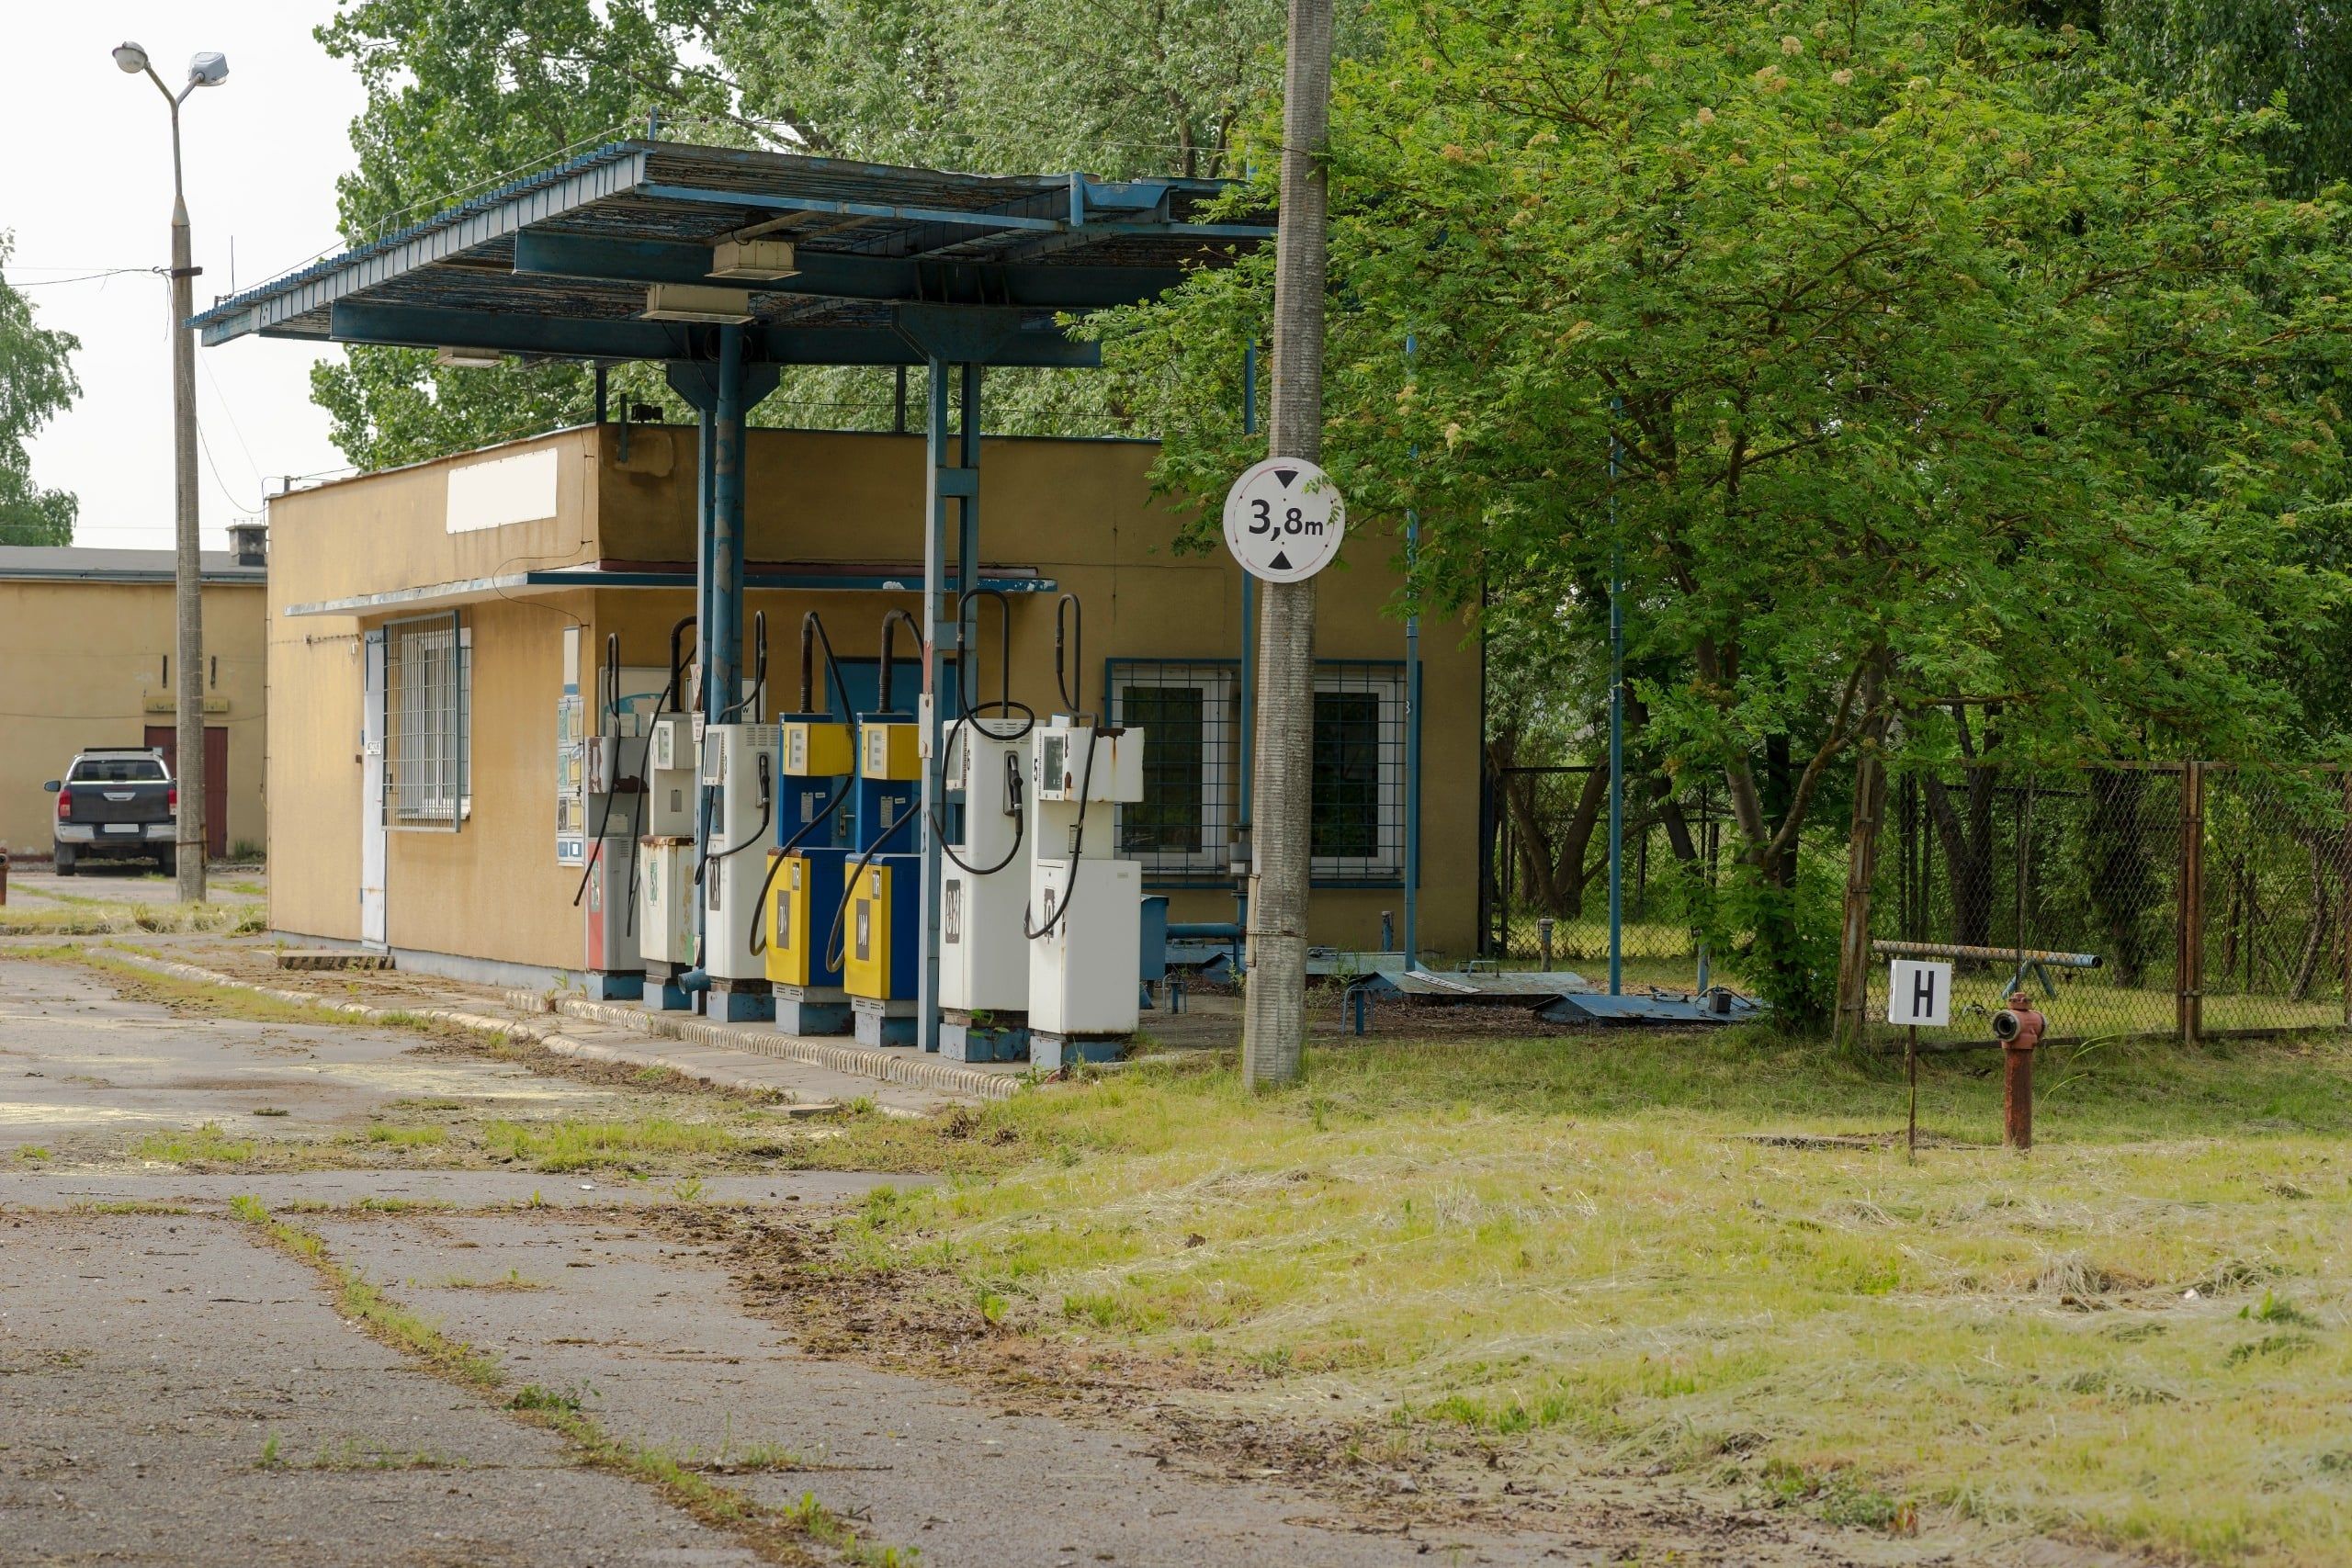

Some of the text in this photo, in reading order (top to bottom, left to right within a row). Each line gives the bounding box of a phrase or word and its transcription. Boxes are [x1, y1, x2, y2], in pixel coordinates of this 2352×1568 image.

[1249, 499, 1324, 542] 3,8m
[967, 750, 971, 771] 6
[1034, 758, 1038, 782] 5
[1912, 970, 1935, 1018] H
